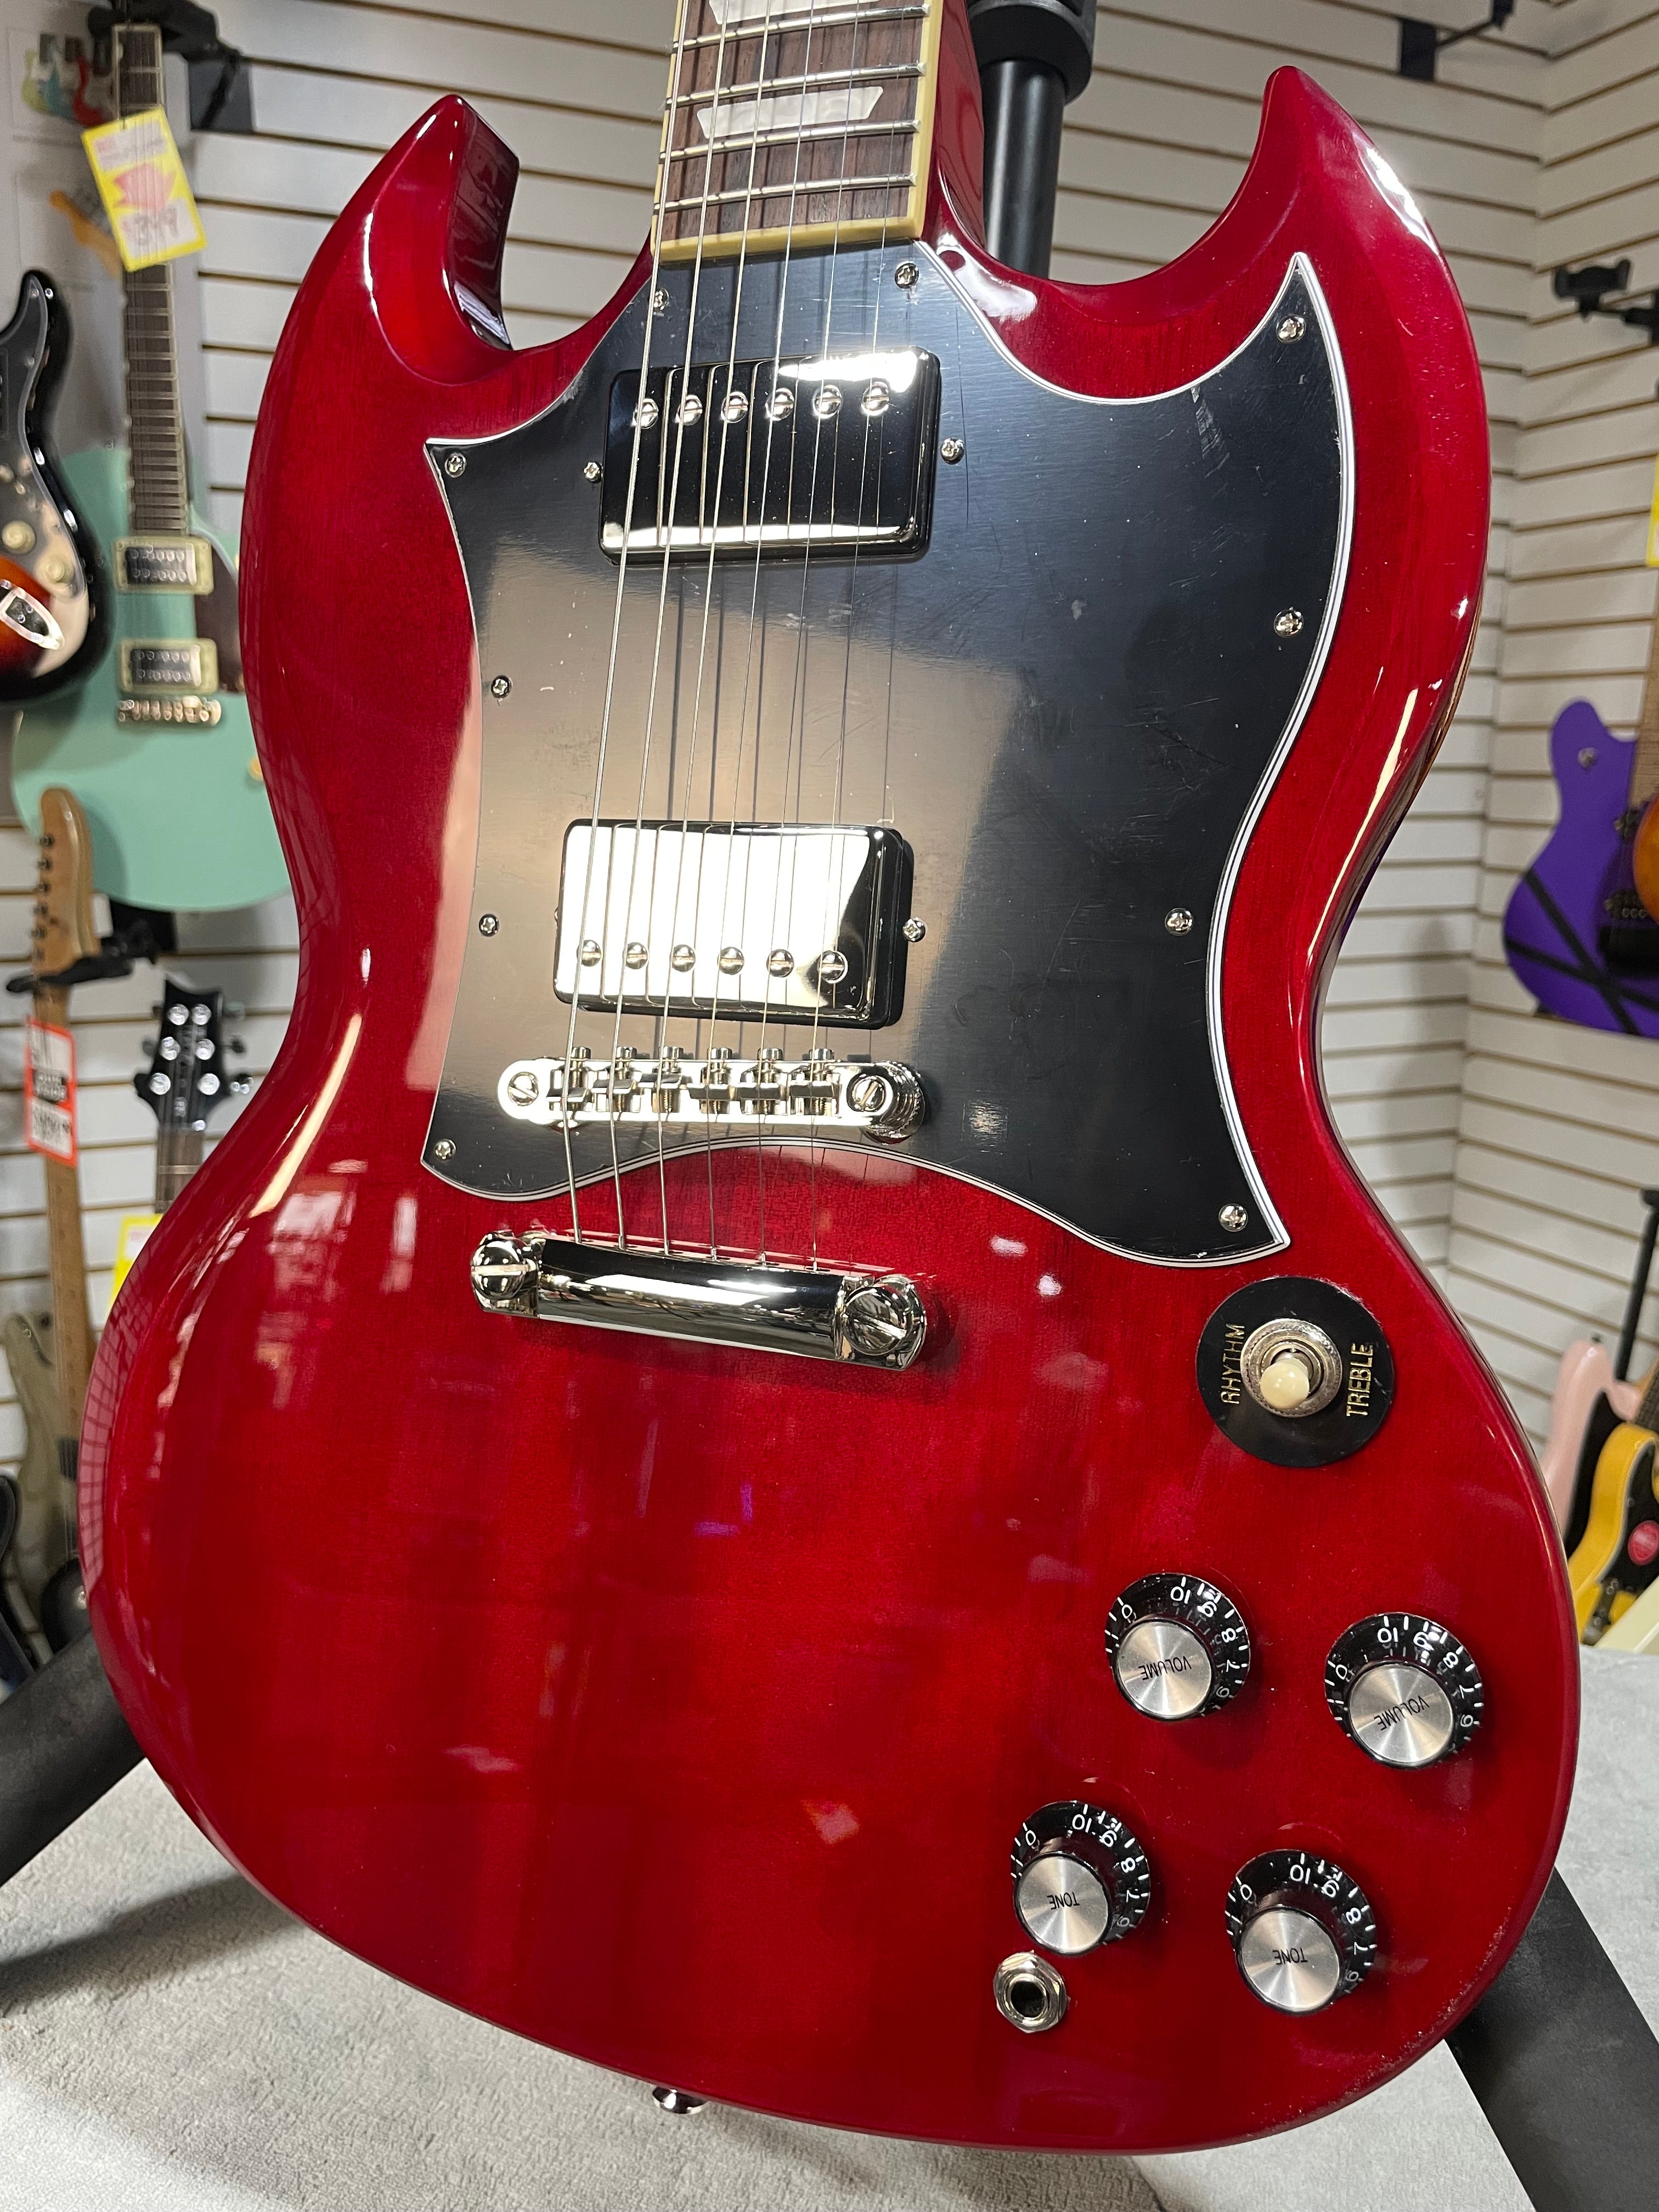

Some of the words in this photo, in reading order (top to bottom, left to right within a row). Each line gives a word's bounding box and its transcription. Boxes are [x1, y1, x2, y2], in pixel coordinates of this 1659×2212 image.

[1221, 1324, 1245, 1404] RHYTHM
[1346, 1343, 1374, 1417] TREBLE
[1170, 1586, 1191, 1604] 10
[1121, 1604, 1133, 1618] 0
[1221, 1628, 1236, 1643] 8
[1377, 1627, 1398, 1643] 10
[1138, 1656, 1192, 1680] VOLUME
[1226, 1659, 1240, 1672] 7
[1443, 1652, 1459, 1668] 8
[1335, 1664, 1347, 1679] 0
[1459, 1685, 1474, 1699] 7
[1373, 1695, 1430, 1731] VOLUME
[1072, 1814, 1092, 1833] 10
[1025, 1830, 1036, 1846] 0
[1121, 1857, 1136, 1873] 8
[1290, 1864, 1311, 1884] 10
[1126, 1889, 1140, 1903] 7
[1240, 1884, 1252, 1900] 0
[1047, 1891, 1080, 1910] TONE
[1346, 1908, 1362, 1924] 8
[1354, 1942, 1368, 1955] 7
[1272, 1948, 1308, 1966] TONE
